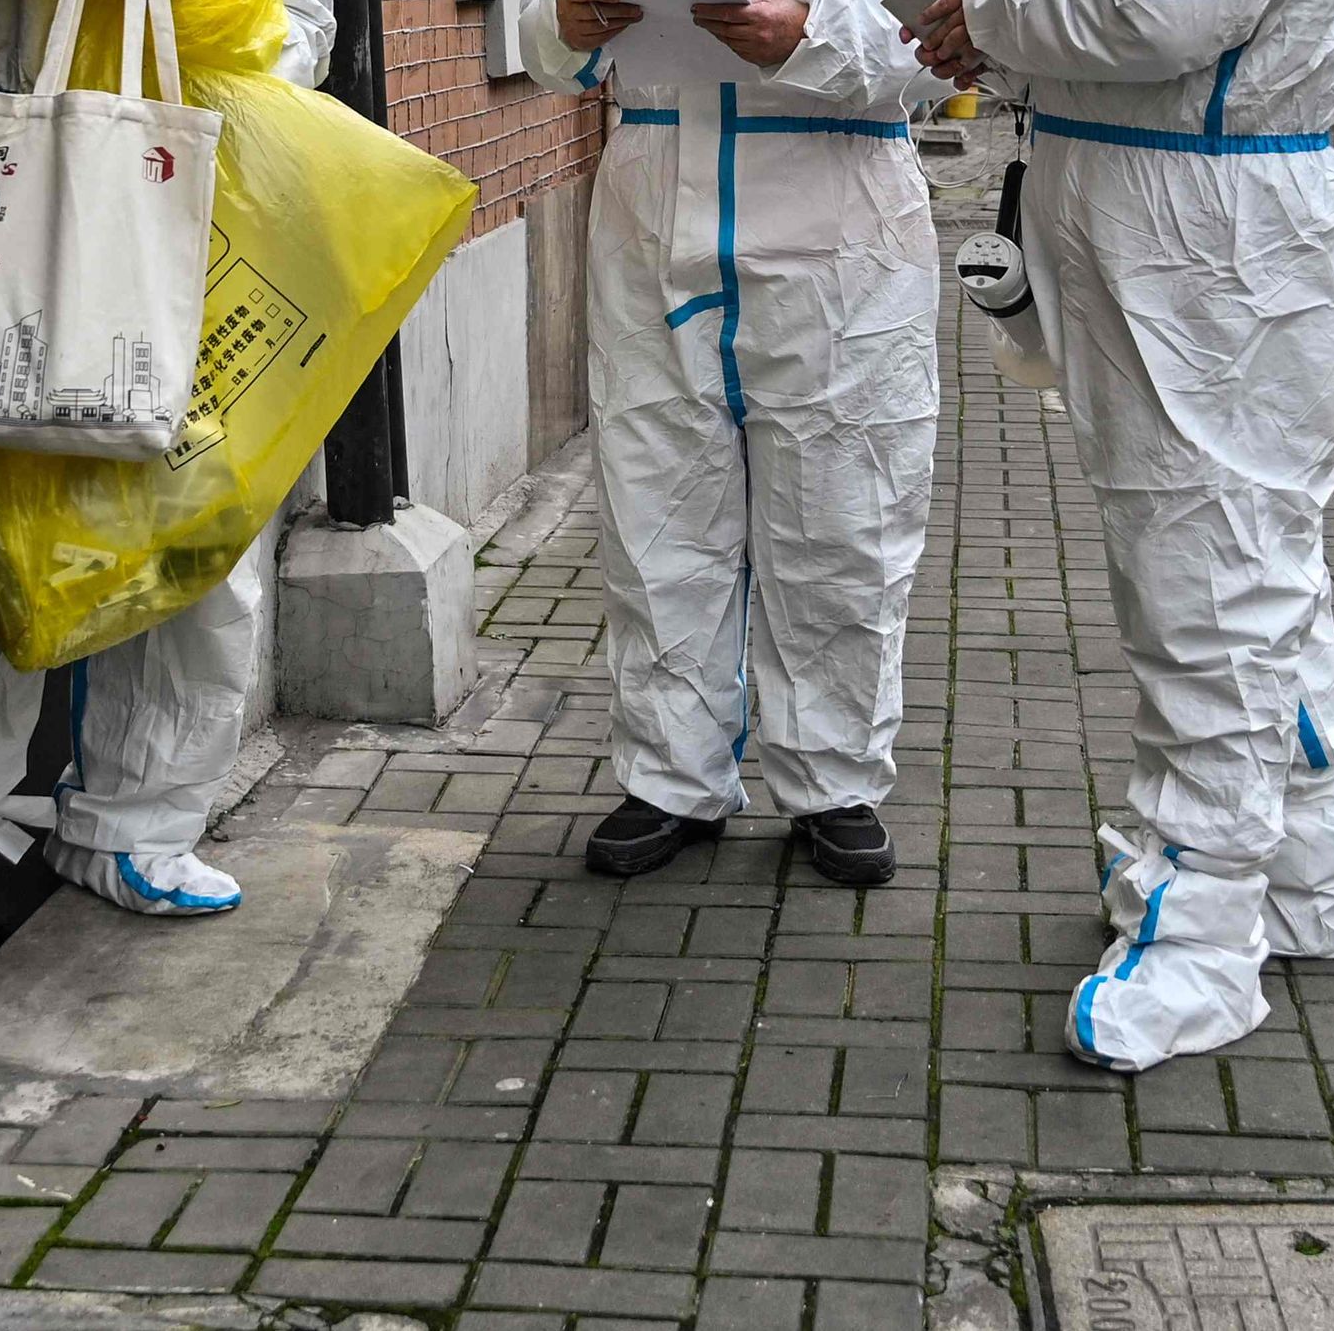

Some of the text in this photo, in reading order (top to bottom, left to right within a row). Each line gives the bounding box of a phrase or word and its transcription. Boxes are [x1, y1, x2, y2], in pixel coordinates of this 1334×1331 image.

[213, 317, 267, 374] 化学性废物
[265, 339, 276, 350] 月
[283, 317, 293, 328] 日
